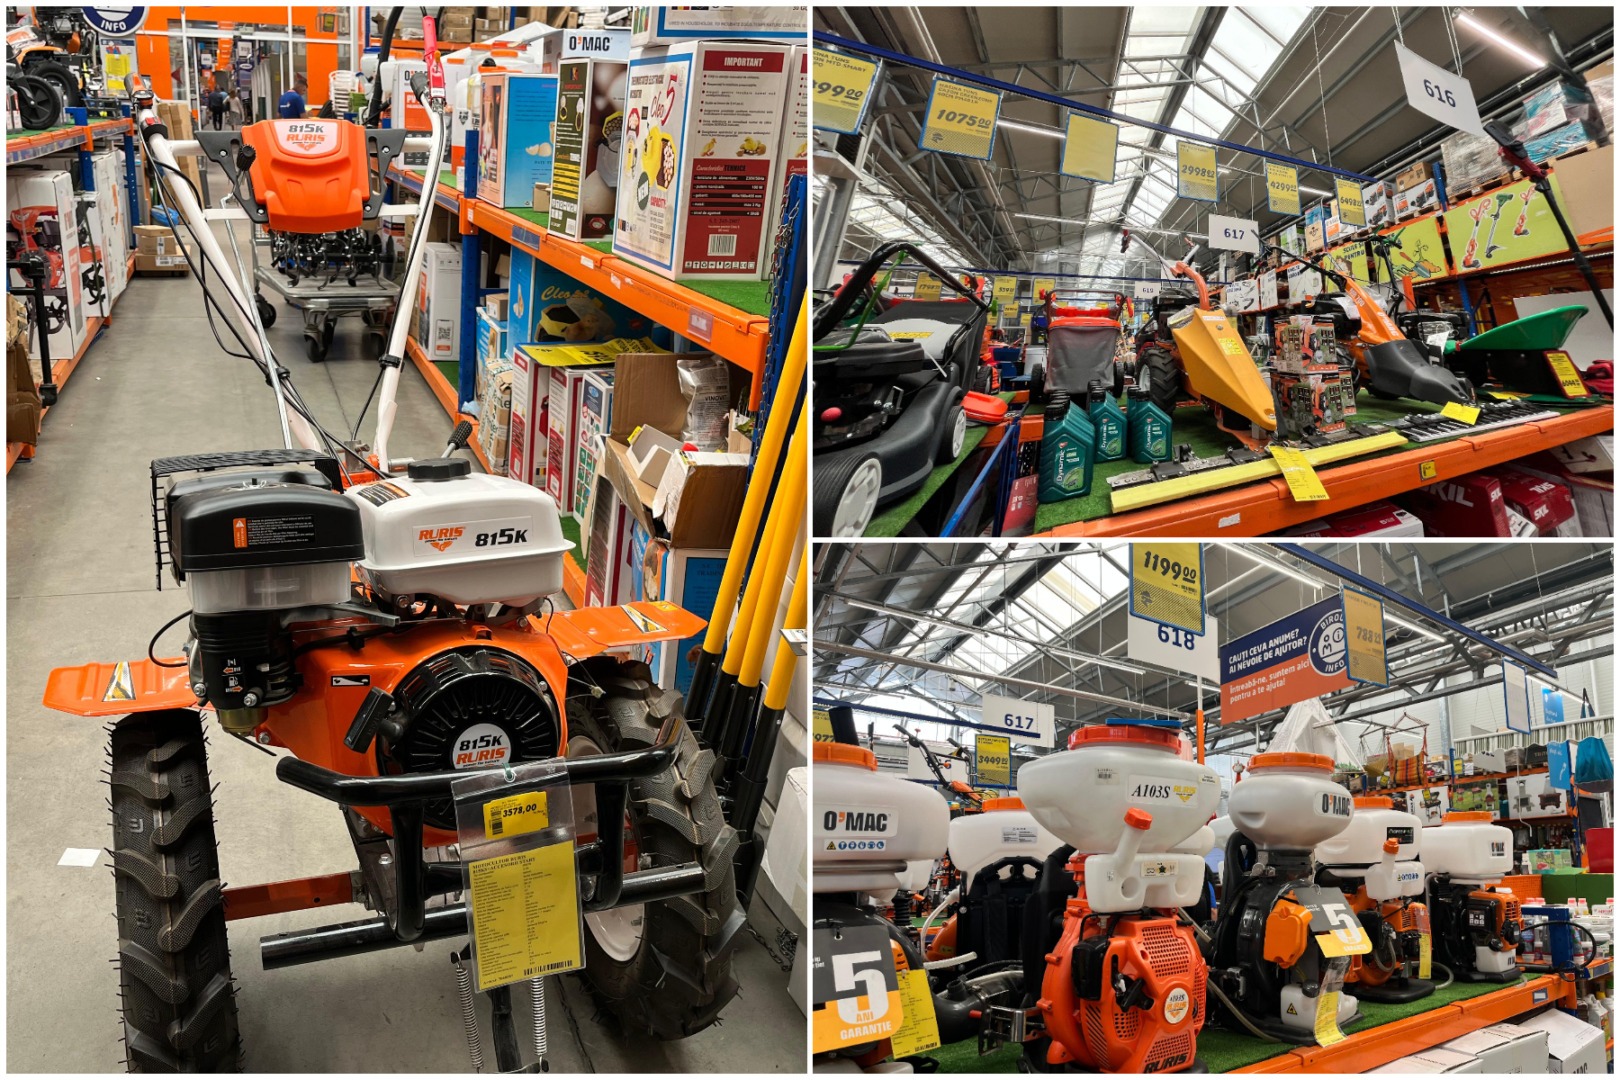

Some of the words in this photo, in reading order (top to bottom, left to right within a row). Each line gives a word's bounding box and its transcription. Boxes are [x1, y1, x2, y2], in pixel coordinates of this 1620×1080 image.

[101, 20, 127, 31] INFO
[569, 36, 610, 51] O'MAC
[724, 57, 763, 67] IMPORTANT
[1423, 79, 1456, 108] 616
[289, 123, 325, 133] 815K
[286, 133, 326, 142] RURIS
[1224, 228, 1245, 240] 617
[541, 286, 571, 300] Cleo
[1056, 449, 1066, 482] Dynamic
[1534, 504, 1549, 521] SKIL
[418, 526, 464, 541] RURIS
[475, 528, 528, 547] 815K
[1158, 623, 1195, 651] 618
[1249, 642, 1267, 656] CEVA
[1268, 628, 1300, 648] ANUME?
[1229, 664, 1237, 674] AI
[1237, 654, 1263, 671] NEVOIE
[1263, 650, 1273, 661] DE
[1274, 636, 1308, 657] AJUTOR?
[1269, 665, 1296, 681] suntem
[1296, 659, 1310, 671] aici
[1324, 659, 1345, 672] INFO
[1229, 690, 1251, 705] pentru
[1257, 685, 1265, 694] te
[1265, 677, 1286, 693] ajuta!
[1004, 713, 1034, 730] 617
[460, 735, 502, 751] 815K
[456, 747, 508, 765] RURIS
[1131, 784, 1171, 799] A103S
[503, 803, 538, 818] 3578,00
[823, 810, 888, 833] O'MAC
[1321, 903, 1362, 945] 5
[832, 950, 890, 1025] 5
[856, 1011, 875, 1023] ANI
[1144, 1051, 1190, 1074] RURIS
